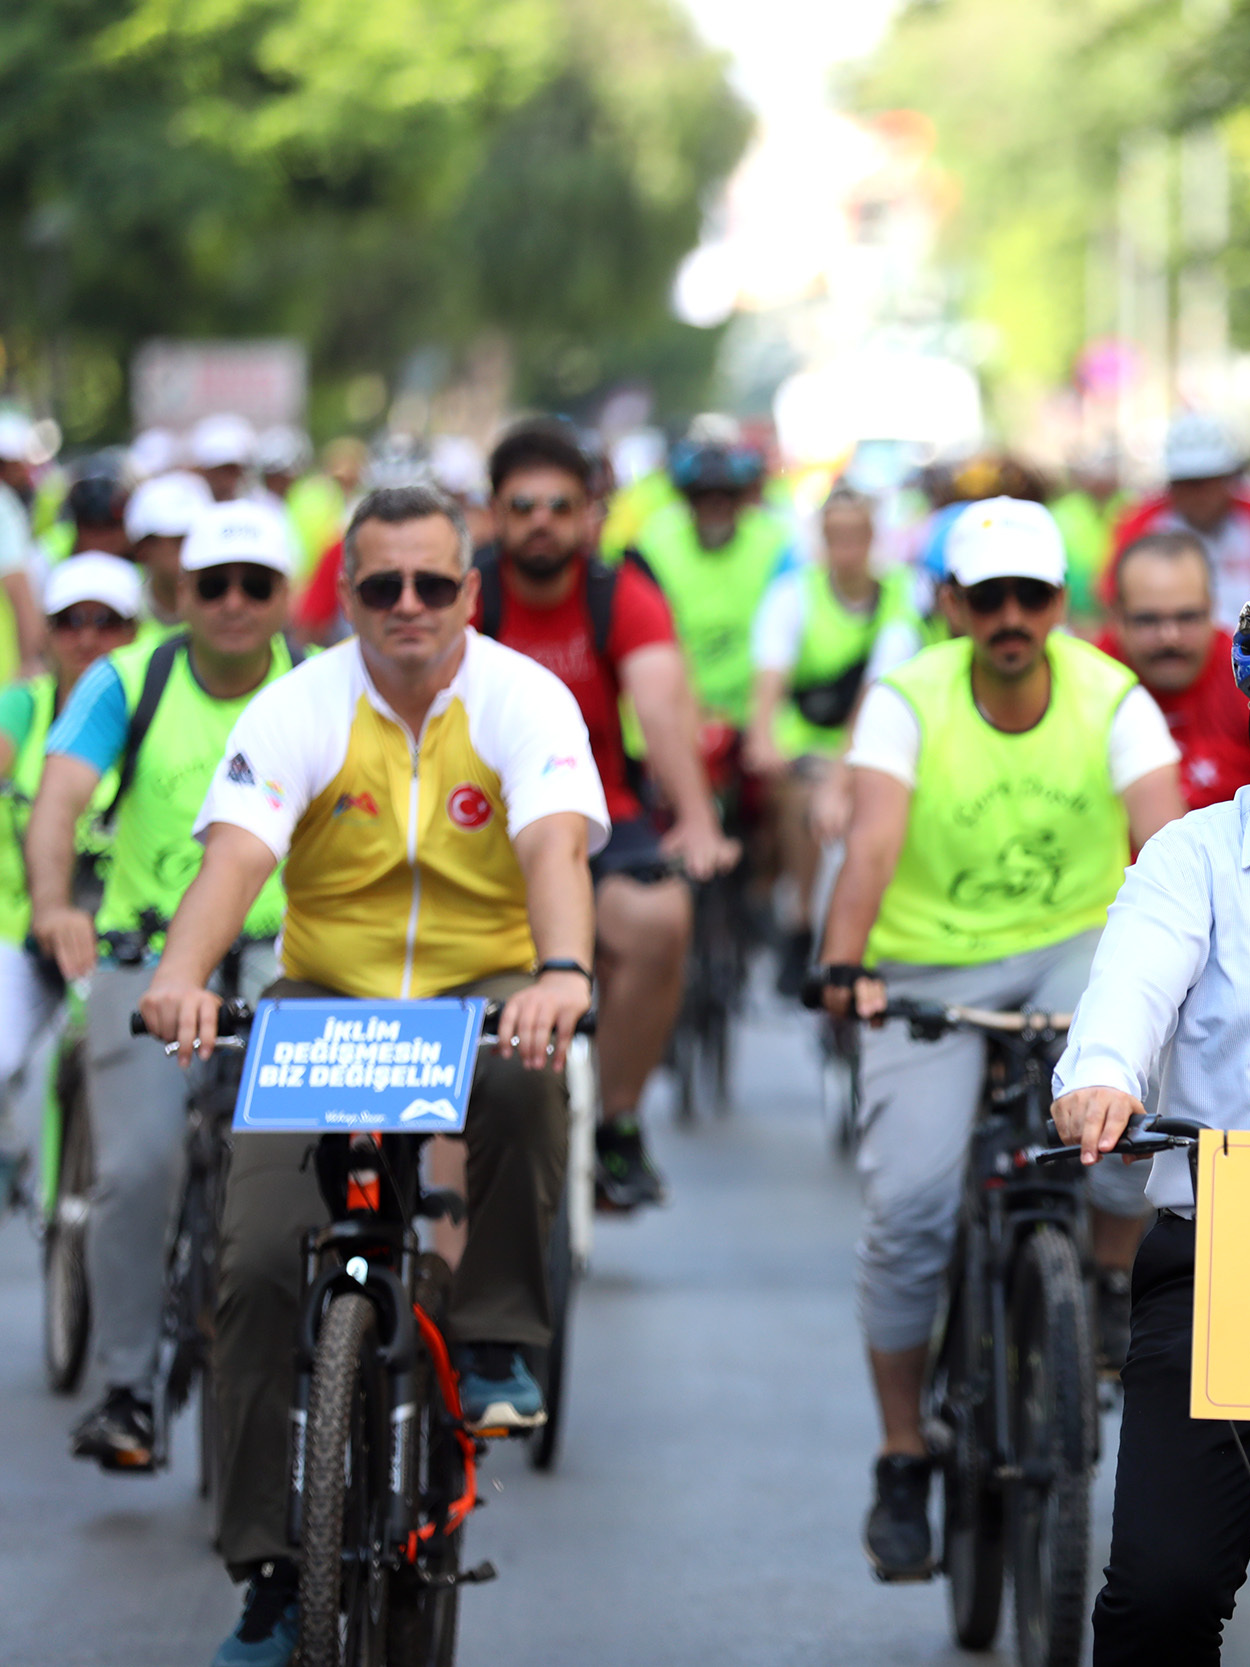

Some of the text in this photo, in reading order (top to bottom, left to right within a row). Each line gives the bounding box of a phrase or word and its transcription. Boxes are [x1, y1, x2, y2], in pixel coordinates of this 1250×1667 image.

[322, 1015, 401, 1043] İKLİM
[273, 1037, 441, 1068] DEĞİŞMESİN
[258, 1061, 456, 1093] BİZ DEĞİŞELİM
